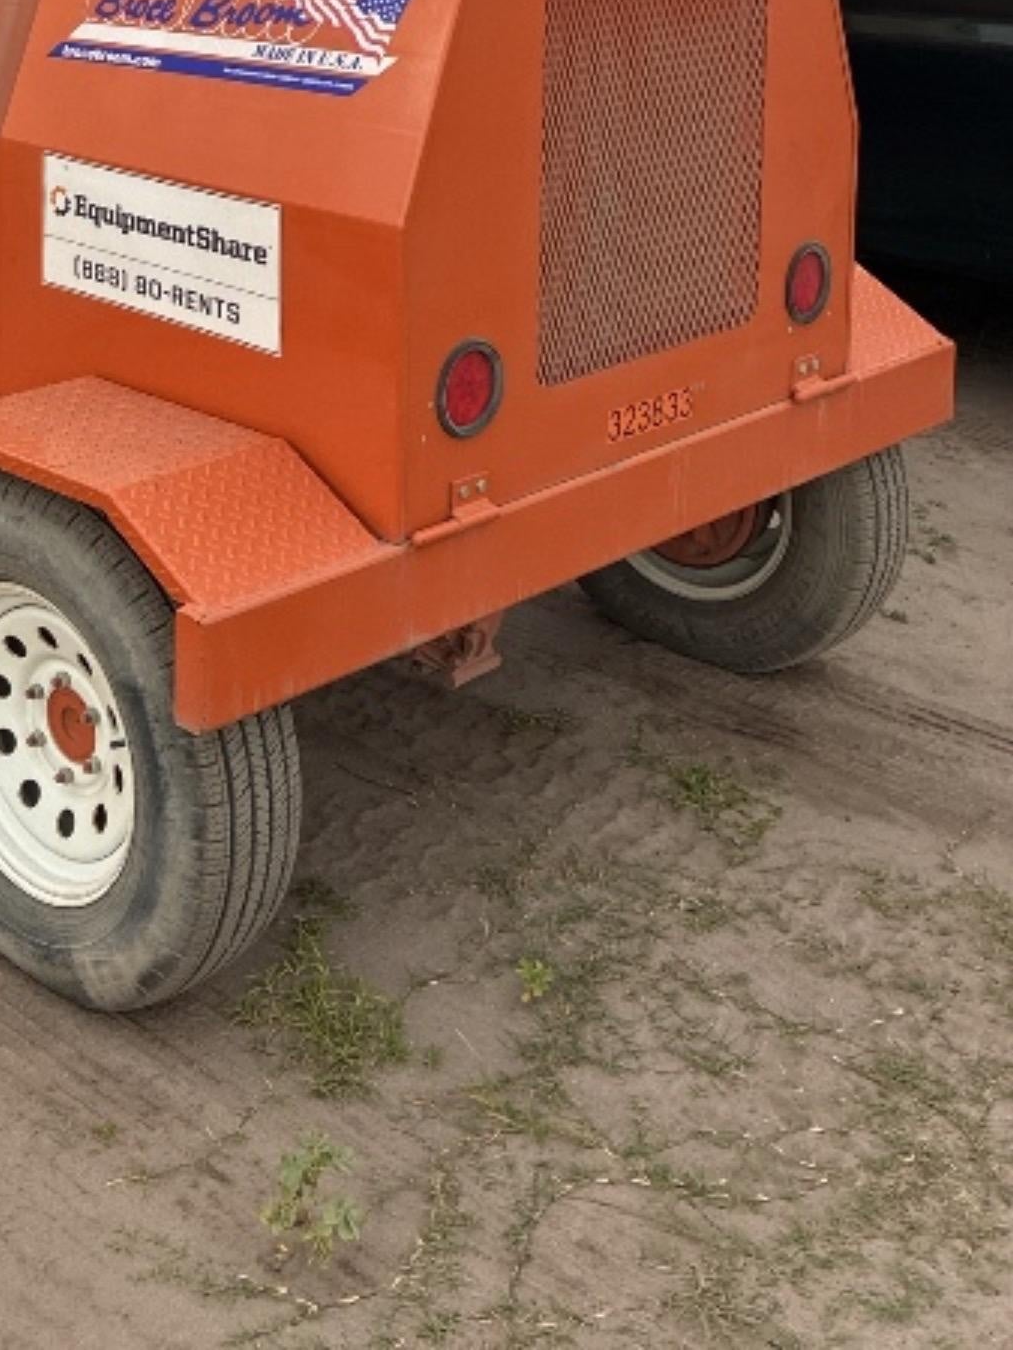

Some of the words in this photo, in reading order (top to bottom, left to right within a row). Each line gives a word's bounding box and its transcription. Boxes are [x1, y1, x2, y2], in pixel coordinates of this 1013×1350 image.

[296, 49, 317, 64] IN
[74, 194, 268, 265] EquipmentShare
[73, 254, 127, 292] (888)
[135, 275, 240, 324] 80-RENTS
